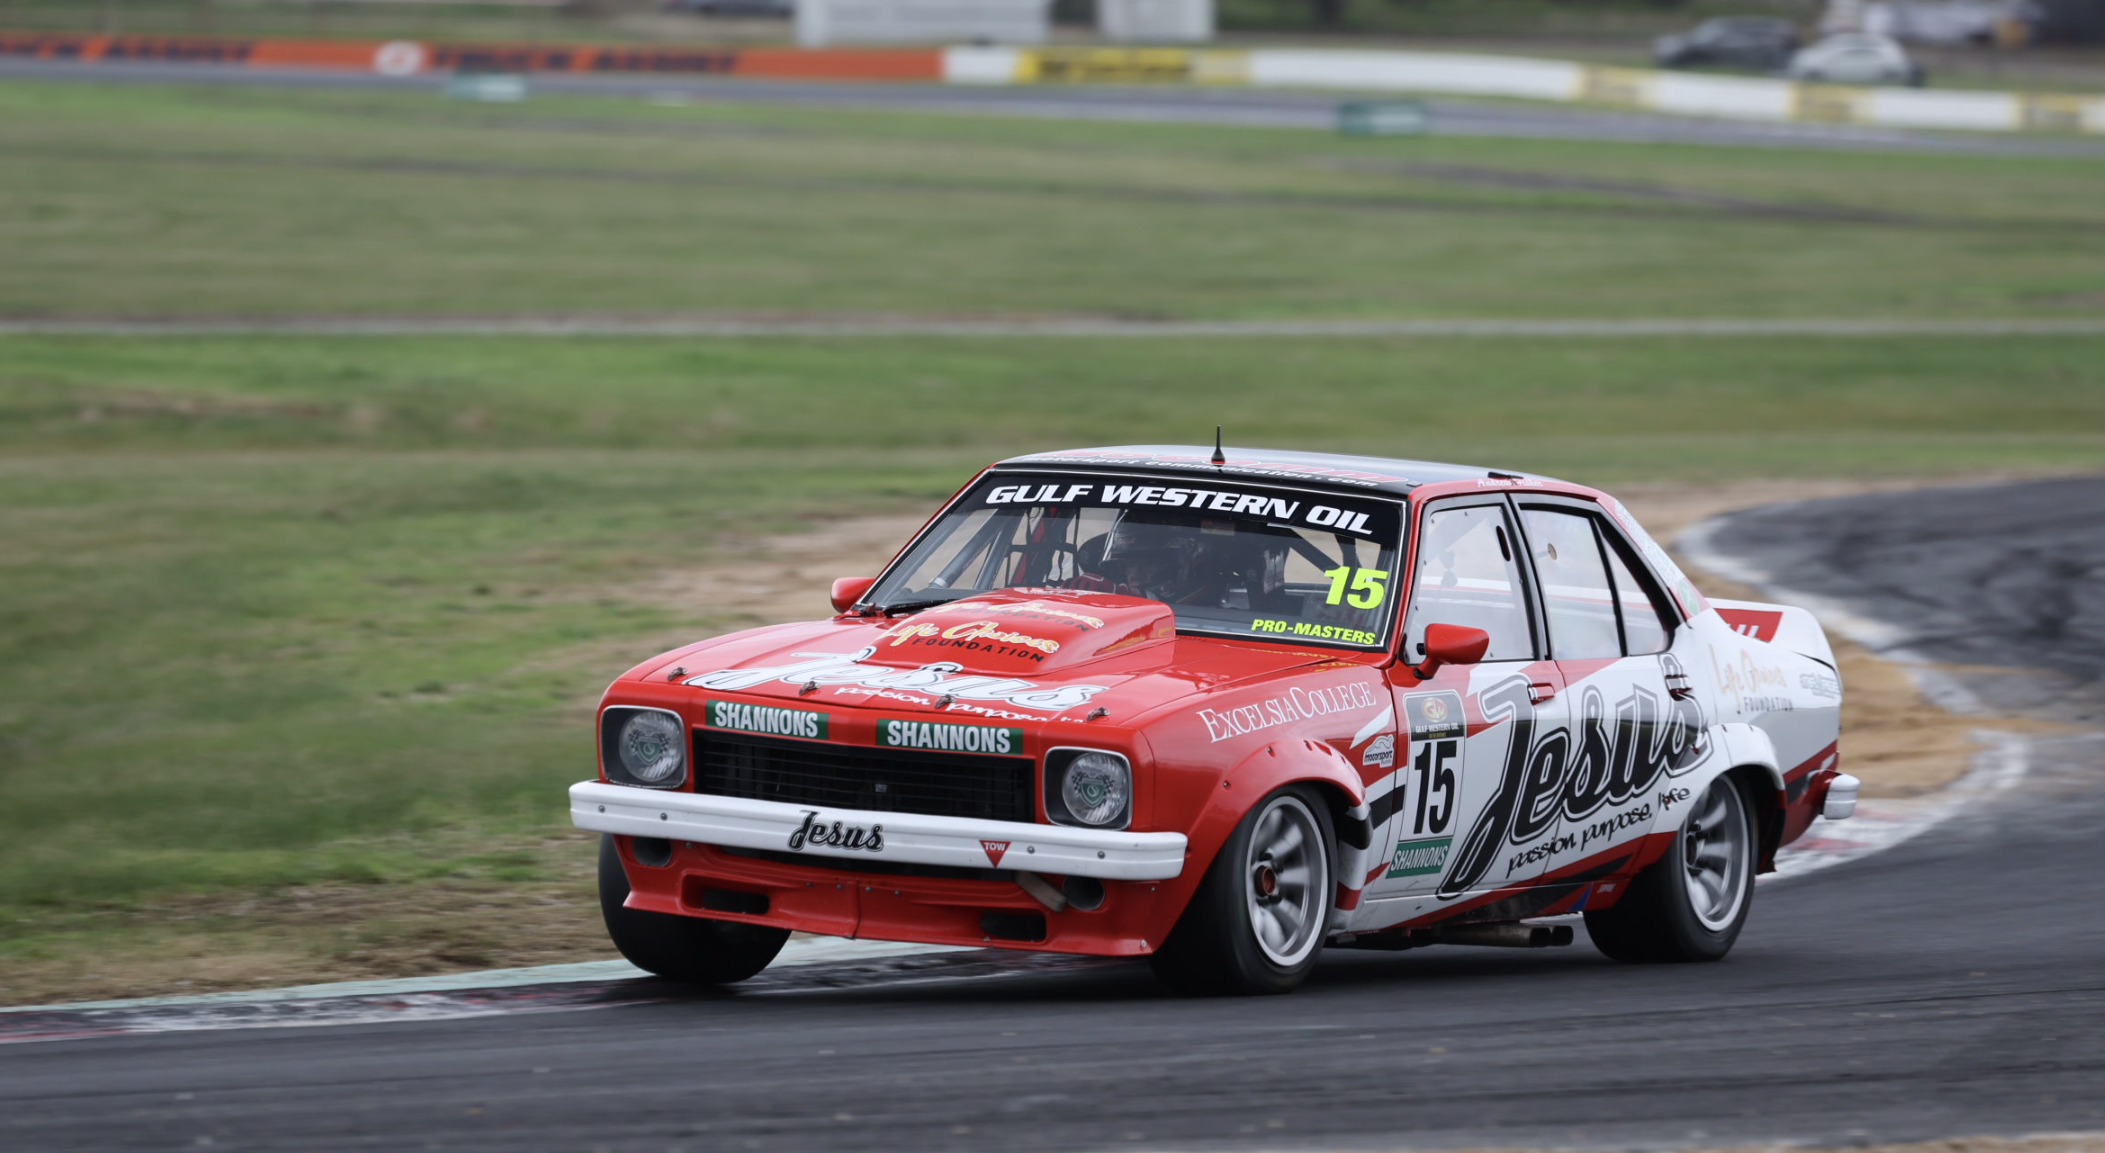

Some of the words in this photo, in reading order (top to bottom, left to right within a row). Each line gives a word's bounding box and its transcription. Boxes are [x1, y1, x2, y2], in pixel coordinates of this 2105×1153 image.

[985, 485, 1094, 504] GULF
[1100, 485, 1300, 519] WESTERN
[1305, 505, 1373, 535] OIL
[1323, 566, 1389, 610] 15
[911, 637, 1045, 662] FOUNDATION
[1251, 619, 1376, 645] PRO-MASTERS
[681, 646, 1111, 711] Jesus
[714, 702, 819, 738] SHANNONS
[886, 720, 1011, 753] SHANNONS
[1413, 740, 1457, 834] 15
[1434, 652, 1713, 901] Jesus
[788, 809, 885, 851] Jesus
[984, 842, 1006, 851] TOW
[1391, 845, 1448, 871] SHANNONS
